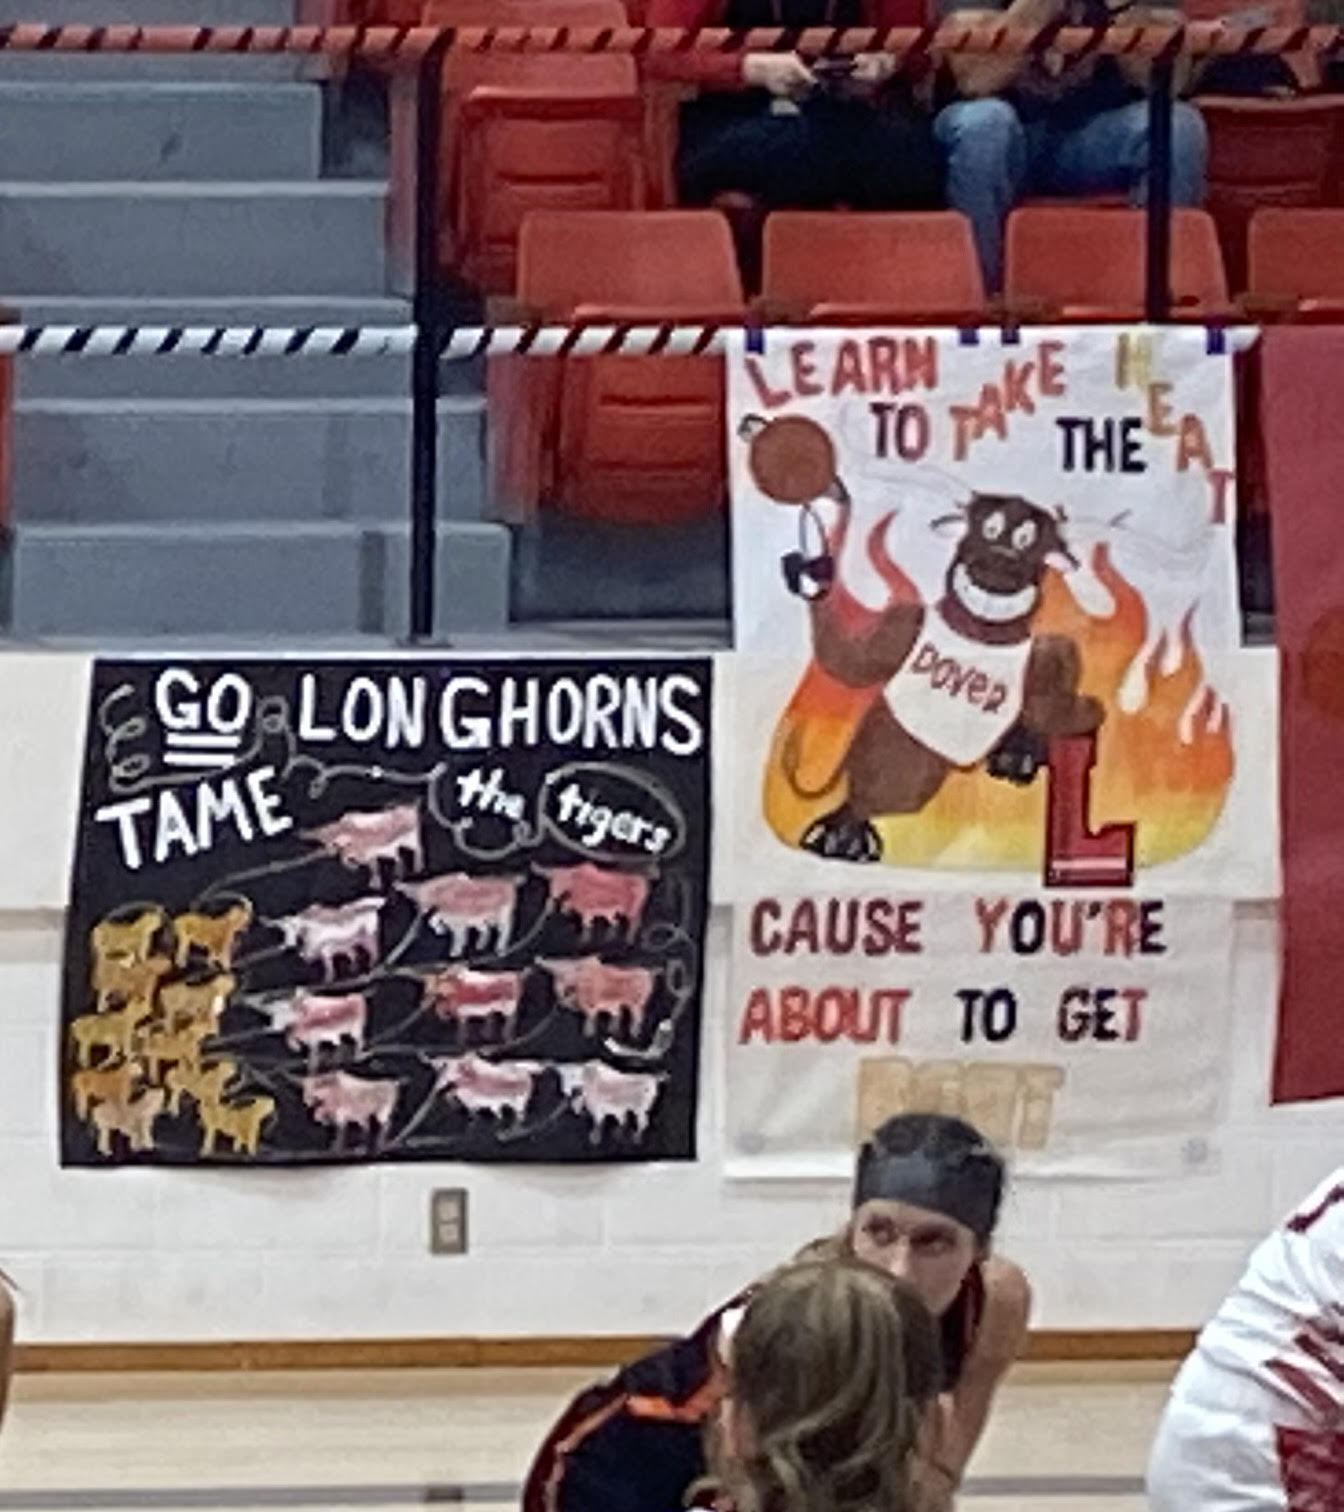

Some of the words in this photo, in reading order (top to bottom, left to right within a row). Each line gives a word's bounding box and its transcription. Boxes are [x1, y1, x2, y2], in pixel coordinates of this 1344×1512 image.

[744, 336, 938, 409] LEARN
[869, 401, 930, 463] TO
[949, 341, 1067, 462] TAKE
[1055, 417, 1148, 473] THE
[1115, 333, 1234, 525] HEAT
[155, 669, 252, 730] GO
[299, 672, 704, 755] LONGHORNS
[95, 766, 293, 870] TAME
[456, 768, 525, 819] the
[558, 783, 671, 853] tigers
[749, 897, 924, 956] CAUSE
[973, 897, 1168, 955] YOU'RE
[737, 986, 912, 1045] ABOUT
[955, 987, 1018, 1043] TO
[1056, 988, 1148, 1043] GET
